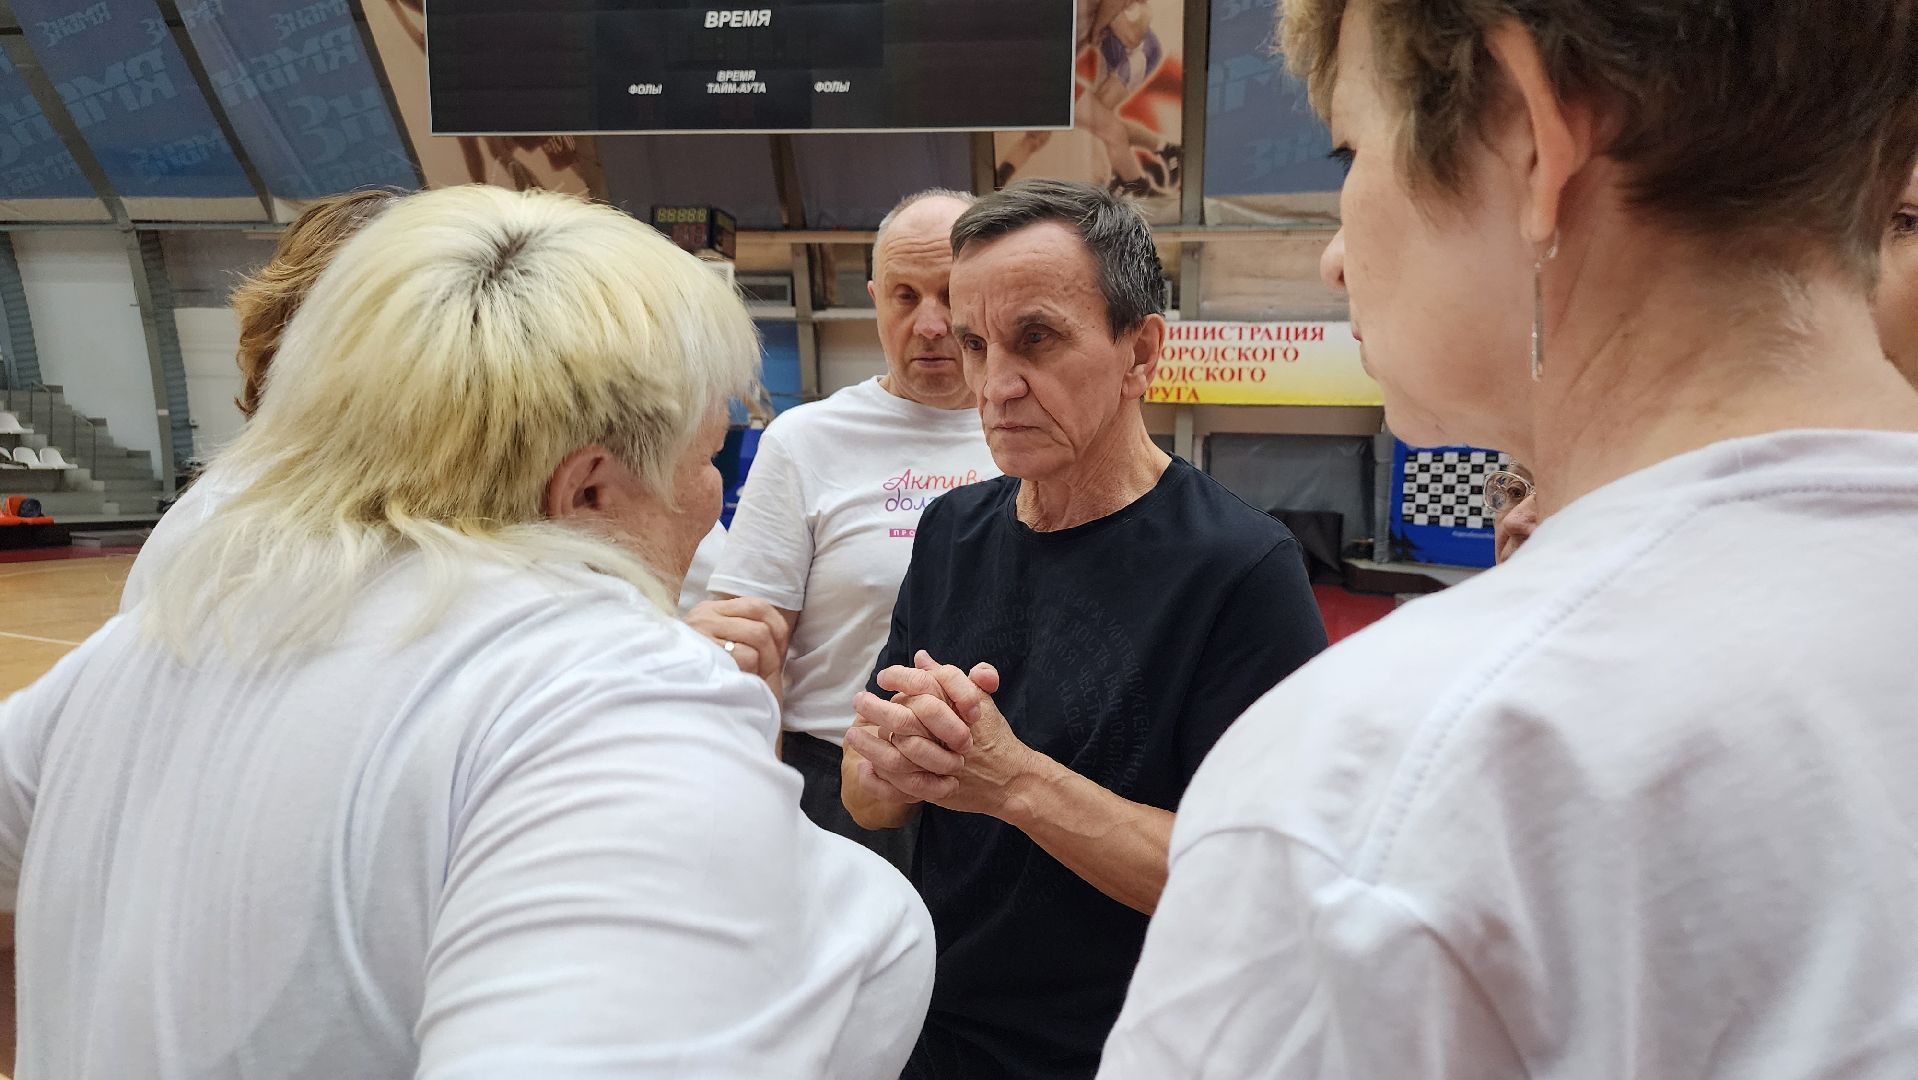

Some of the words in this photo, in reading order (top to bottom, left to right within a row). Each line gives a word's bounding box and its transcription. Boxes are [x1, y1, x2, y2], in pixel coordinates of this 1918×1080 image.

[704, 9, 772, 28] ВРЕМЯ
[716, 69, 756, 82] ВРЕМЯ
[627, 83, 662, 95] ФОЛЫ
[707, 82, 766, 95] ТАЙМ-АУТА
[814, 80, 850, 93] ФОЛЫ
[1157, 366, 1265, 383] ОДСКОГО
[883, 469, 982, 491] Актив
